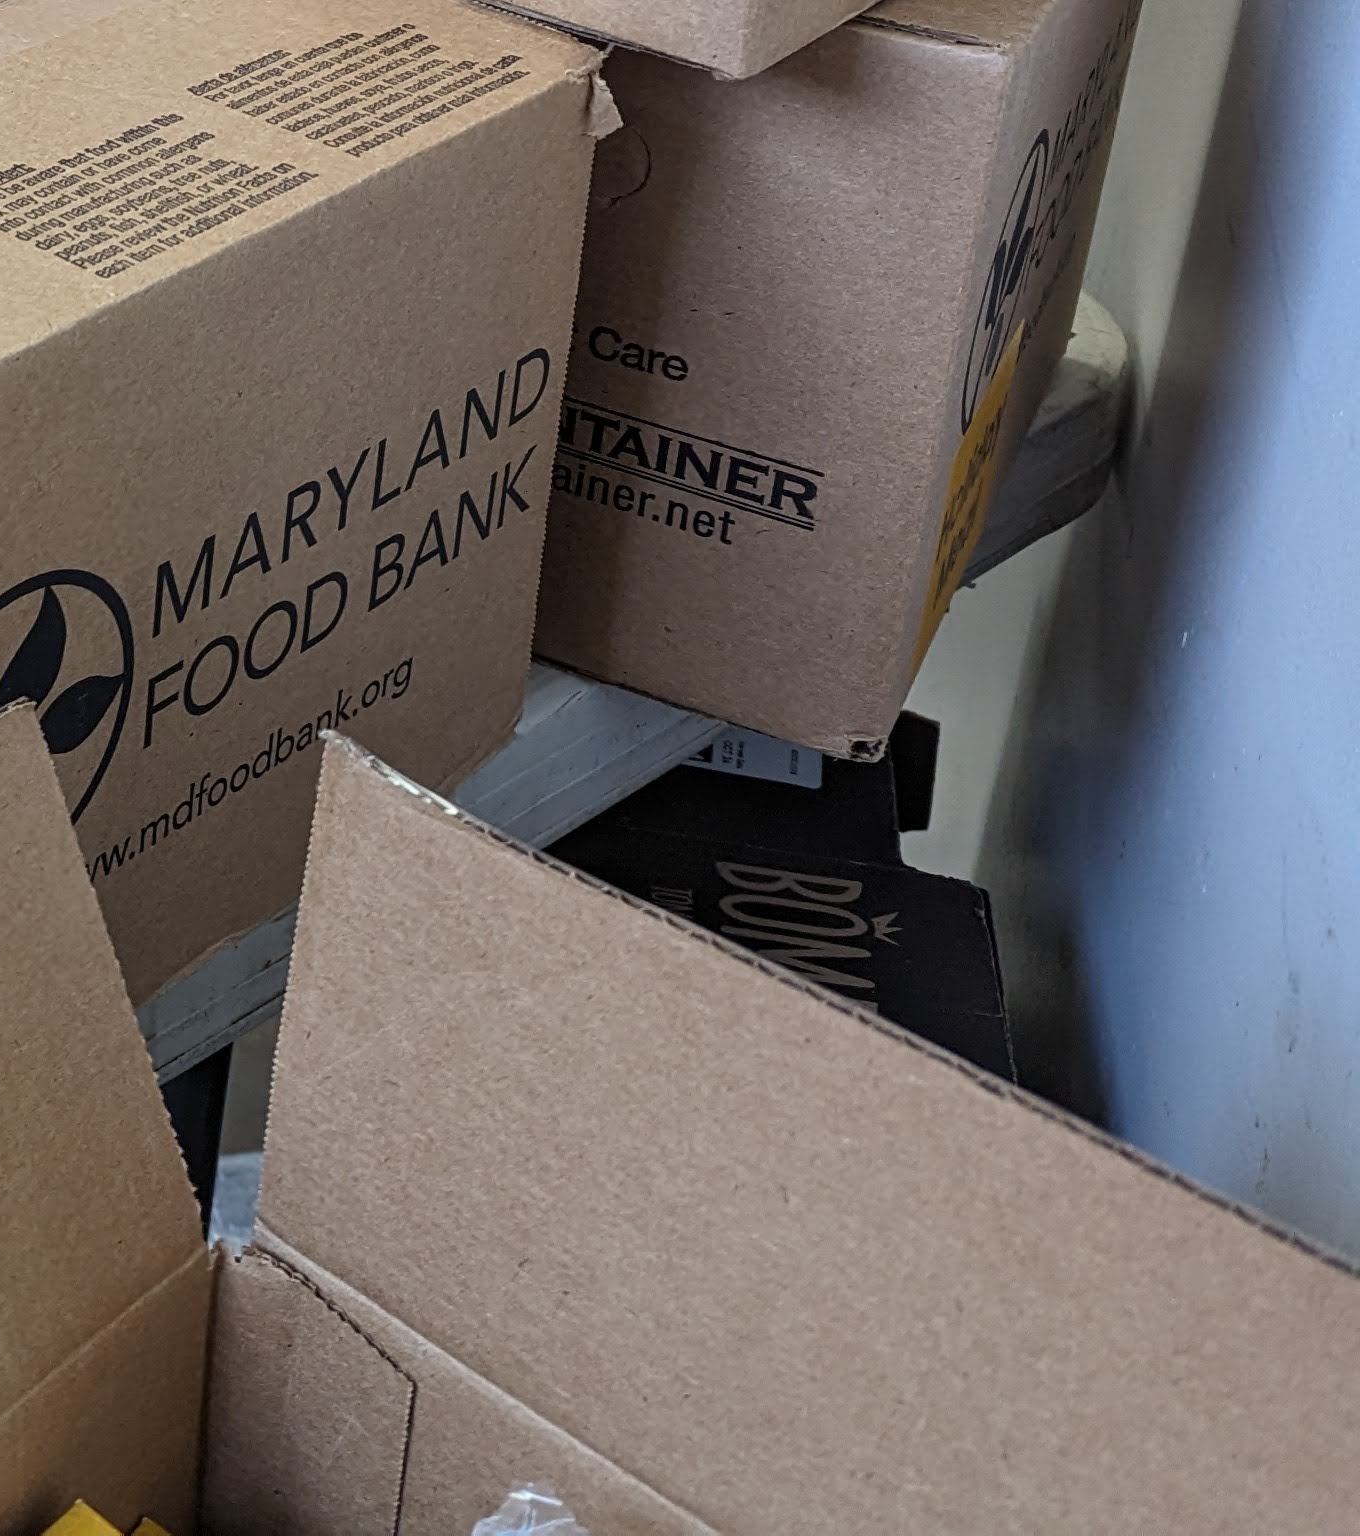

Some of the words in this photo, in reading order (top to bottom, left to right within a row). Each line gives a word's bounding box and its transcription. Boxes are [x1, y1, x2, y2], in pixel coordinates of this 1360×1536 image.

[3, 194, 38, 211] may
[33, 173, 84, 197] contain
[92, 153, 131, 170] have
[127, 137, 167, 155] come
[21, 165, 65, 186] aware
[57, 152, 93, 168] that
[83, 138, 121, 156] food
[150, 113, 184, 127] this
[24, 193, 76, 219] contact
[71, 181, 105, 197] with
[101, 157, 159, 184] common
[15, 217, 66, 241] during
[60, 176, 155, 220] manufacturing
[148, 162, 184, 179] such
[35, 230, 79, 250] dairy,
[72, 214, 116, 232] eggs,
[109, 185, 178, 215] soybeans,
[168, 171, 202, 186] tree
[197, 158, 236, 175] nuts,
[54, 231, 118, 261] peanuts,
[109, 217, 148, 232] fish,
[70, 244, 123, 269] Please
[119, 223, 167, 247] review
[159, 213, 190, 227] the
[182, 187, 243, 215] Nutrition
[235, 171, 277, 190] Facts
[94, 259, 134, 278] each
[125, 243, 165, 262] item
[156, 234, 184, 247] for
[180, 203, 245, 237] additional
[240, 171, 318, 207] information.
[588, 325, 690, 382] Care
[150, 346, 552, 638] MARYLAND
[142, 571, 347, 751] FOOD
[365, 444, 539, 612] BANK
